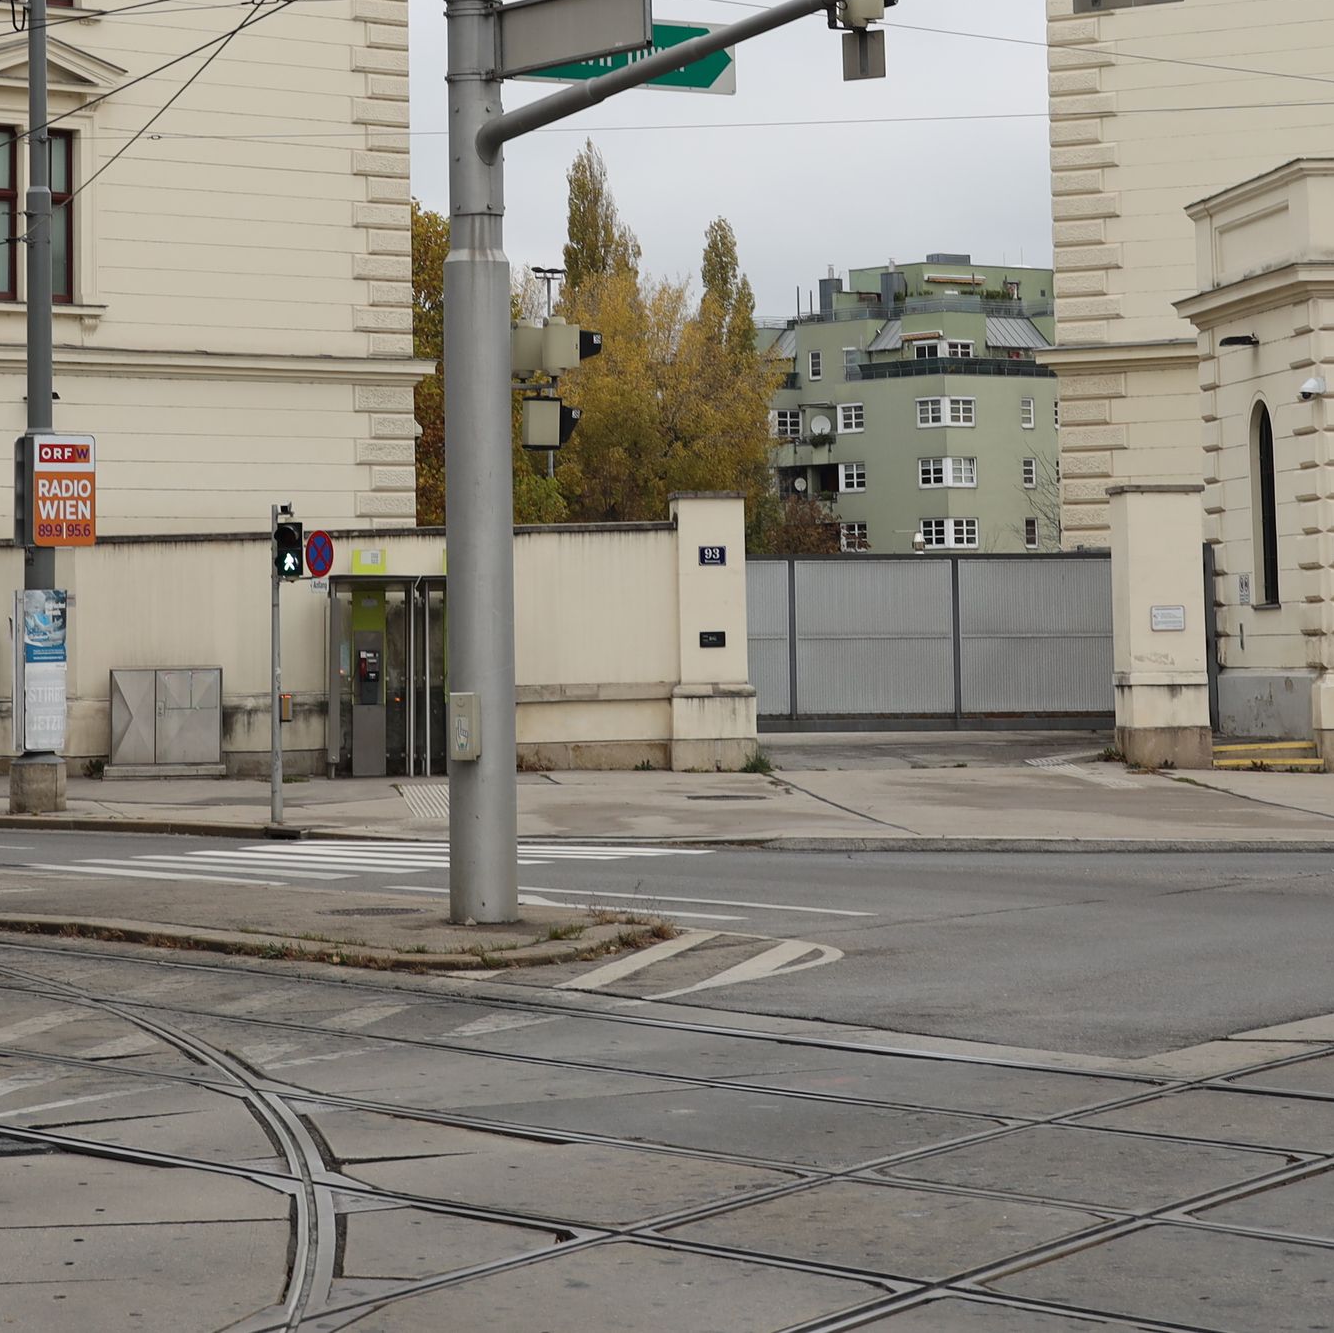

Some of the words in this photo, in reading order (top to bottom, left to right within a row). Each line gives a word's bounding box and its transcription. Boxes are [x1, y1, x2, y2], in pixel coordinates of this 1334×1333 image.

[41, 447, 73, 460] ORF
[75, 448, 90, 459] W
[38, 479, 92, 498] RADIO
[38, 500, 91, 520] WIEN
[38, 524, 63, 537] 89.9
[67, 524, 91, 537] 95.6
[704, 547, 720, 559] 93
